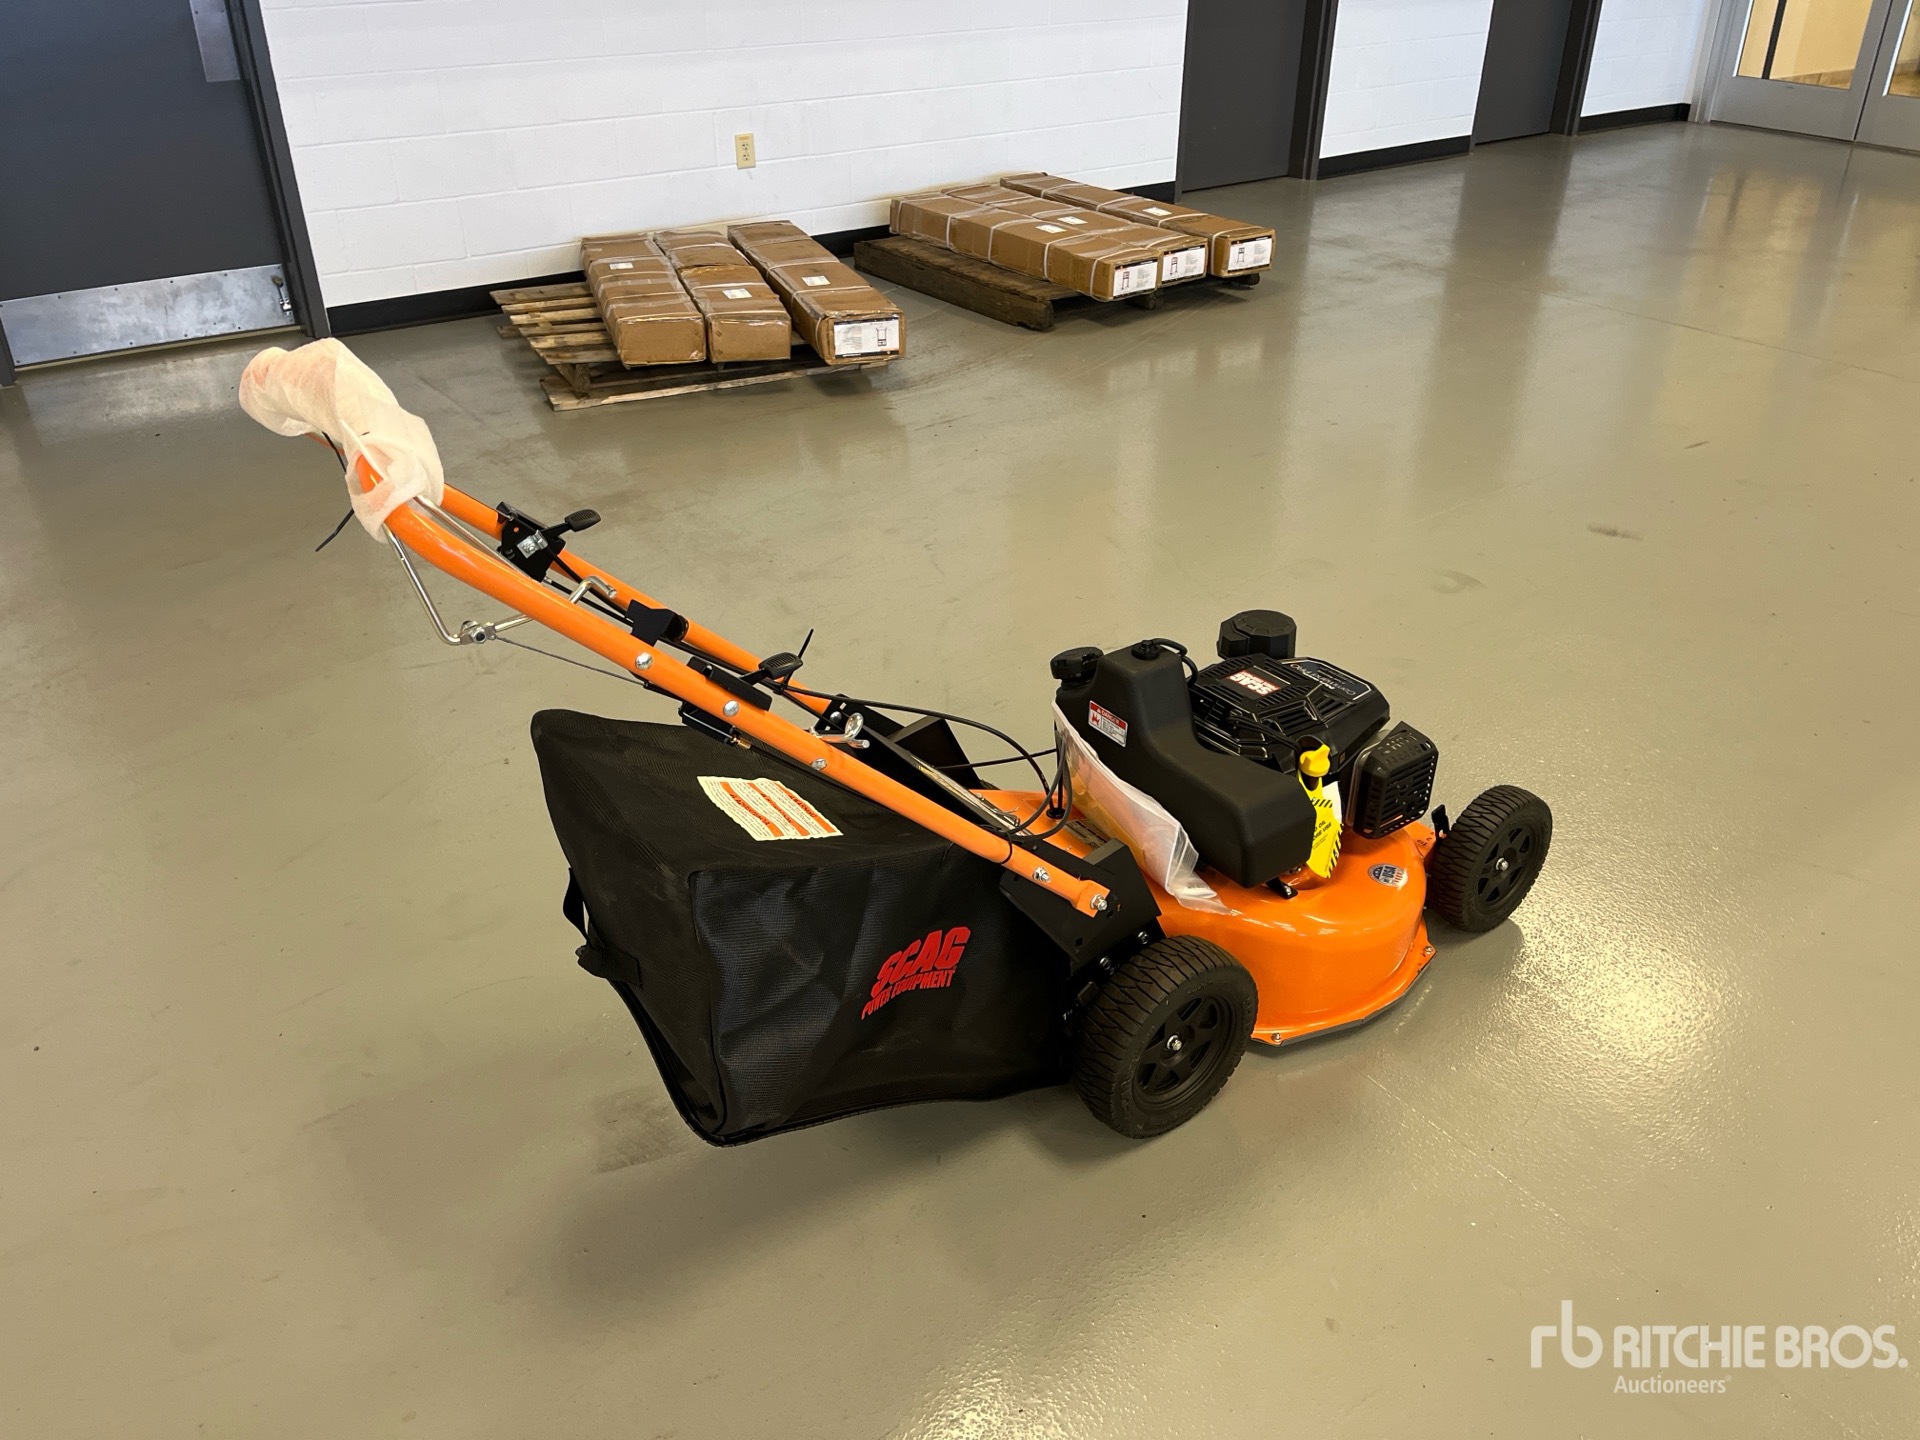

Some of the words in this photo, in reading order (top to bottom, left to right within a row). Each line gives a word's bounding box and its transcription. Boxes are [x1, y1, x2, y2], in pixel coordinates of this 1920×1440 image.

[1229, 671, 1269, 696] SCAG
[870, 926, 971, 999] SCAG
[861, 985, 893, 1020] POWER
[890, 968, 957, 999] EQUIPMENT
